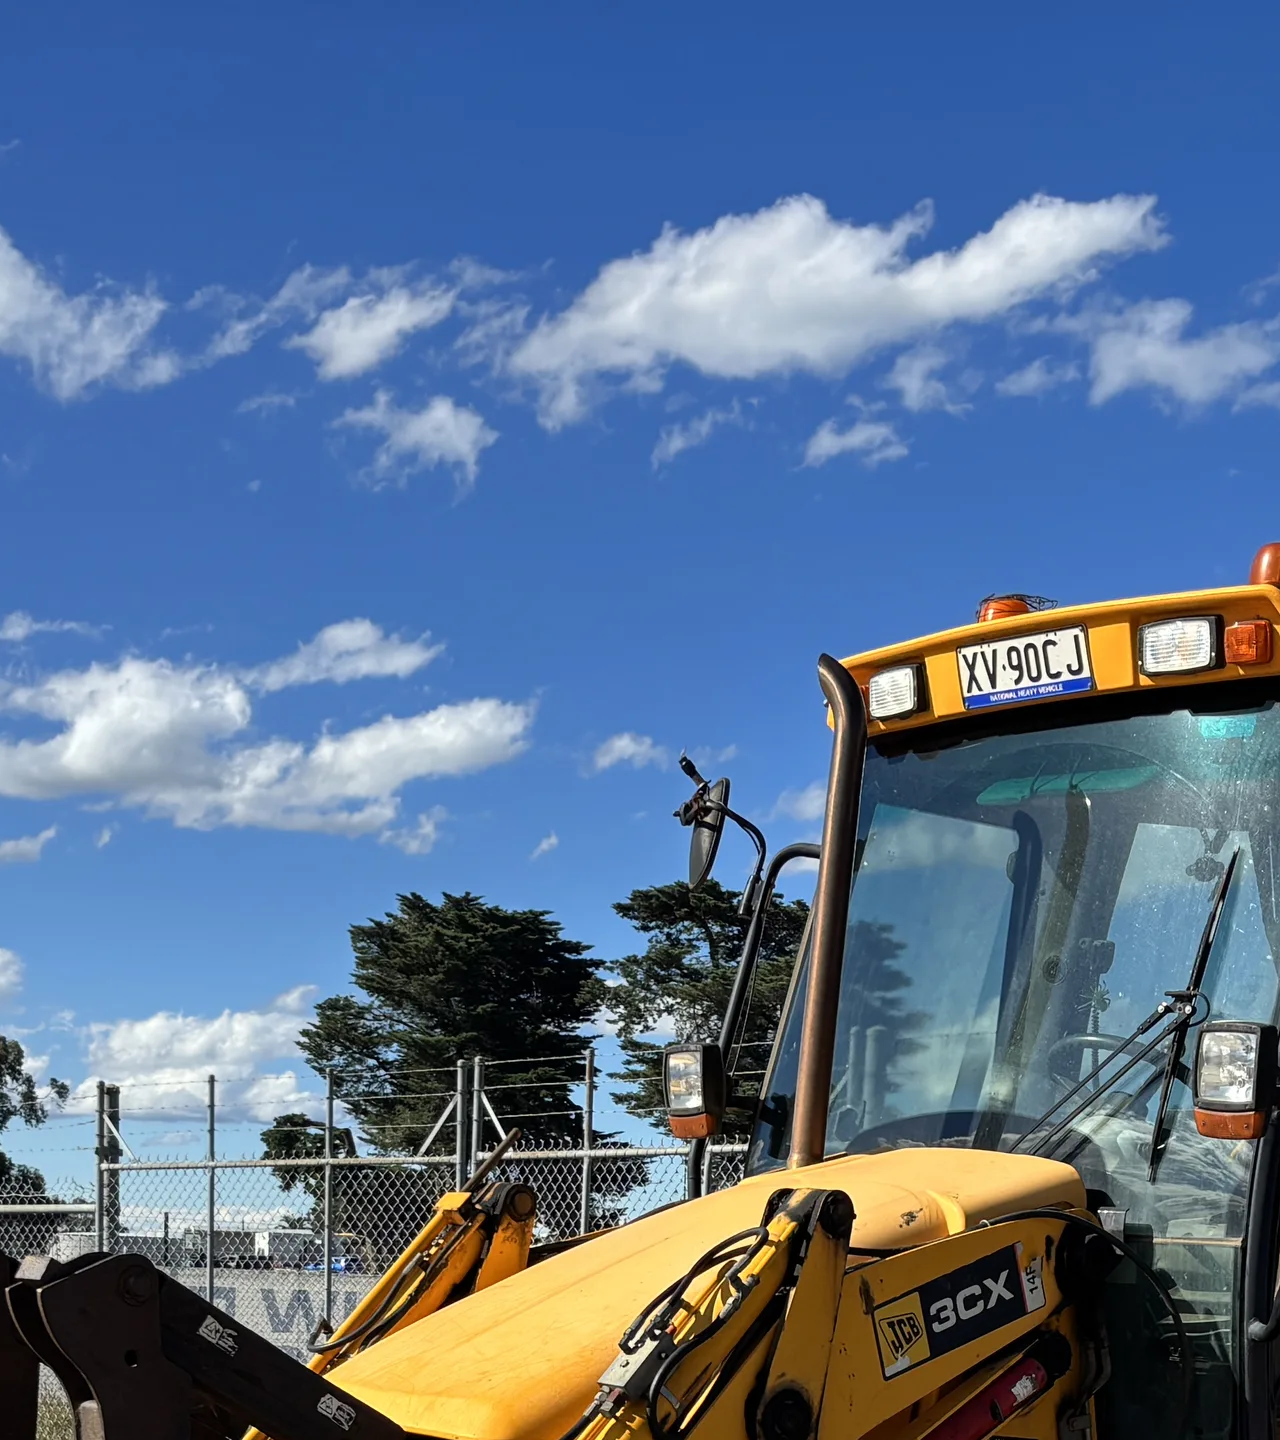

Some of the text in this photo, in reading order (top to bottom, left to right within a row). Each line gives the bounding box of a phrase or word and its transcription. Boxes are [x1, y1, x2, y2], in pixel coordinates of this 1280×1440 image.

[990, 684, 1064, 701] NATIONAL HEAVY VEHICLE
[929, 1269, 1015, 1333] 3CX
[886, 1314, 921, 1353] JCB
